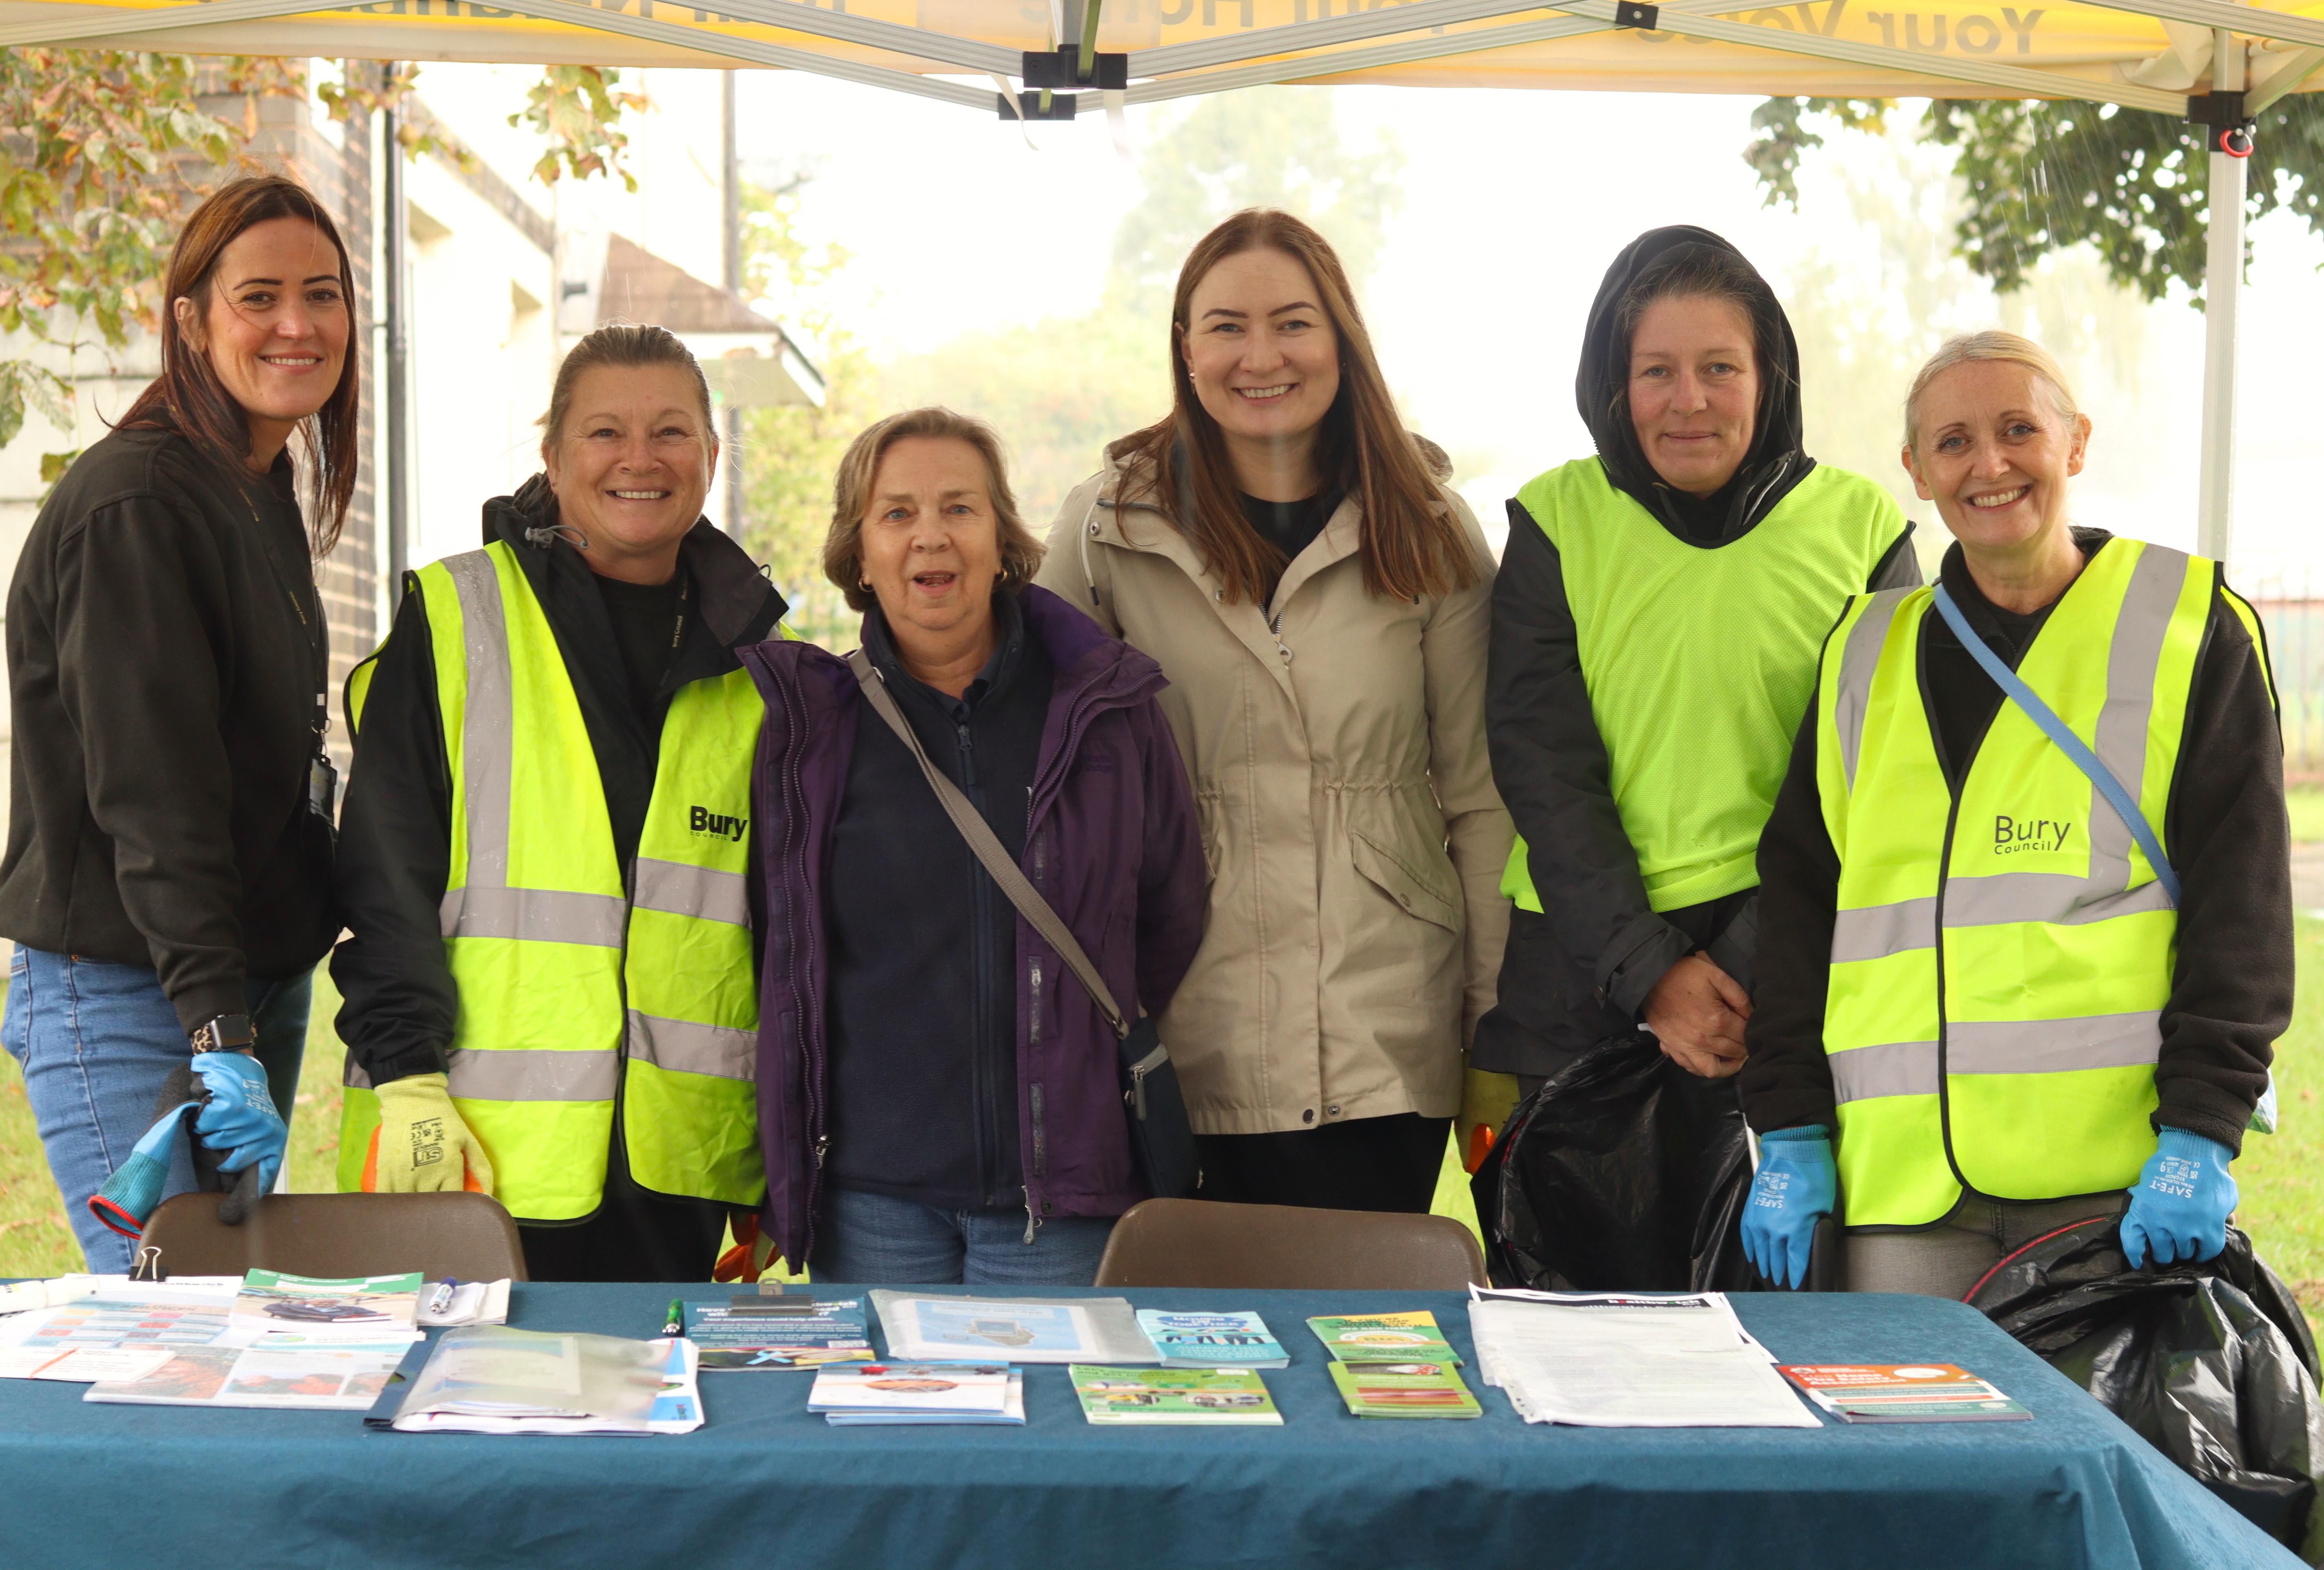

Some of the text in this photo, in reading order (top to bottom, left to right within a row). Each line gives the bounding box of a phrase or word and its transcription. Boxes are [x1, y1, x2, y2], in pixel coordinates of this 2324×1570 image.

[672, 615, 684, 647] Bury Council
[691, 805, 748, 842] Bury
[690, 831, 728, 841] COUNCIL
[1995, 815, 2071, 851] Bury
[1994, 841, 2050, 854] Council
[2160, 1161, 2166, 1173] 9
[2149, 1180, 2193, 1199] SAFE-T
[1754, 1197, 1784, 1209] SAFE-T
[279, 1274, 347, 1283] Independent
